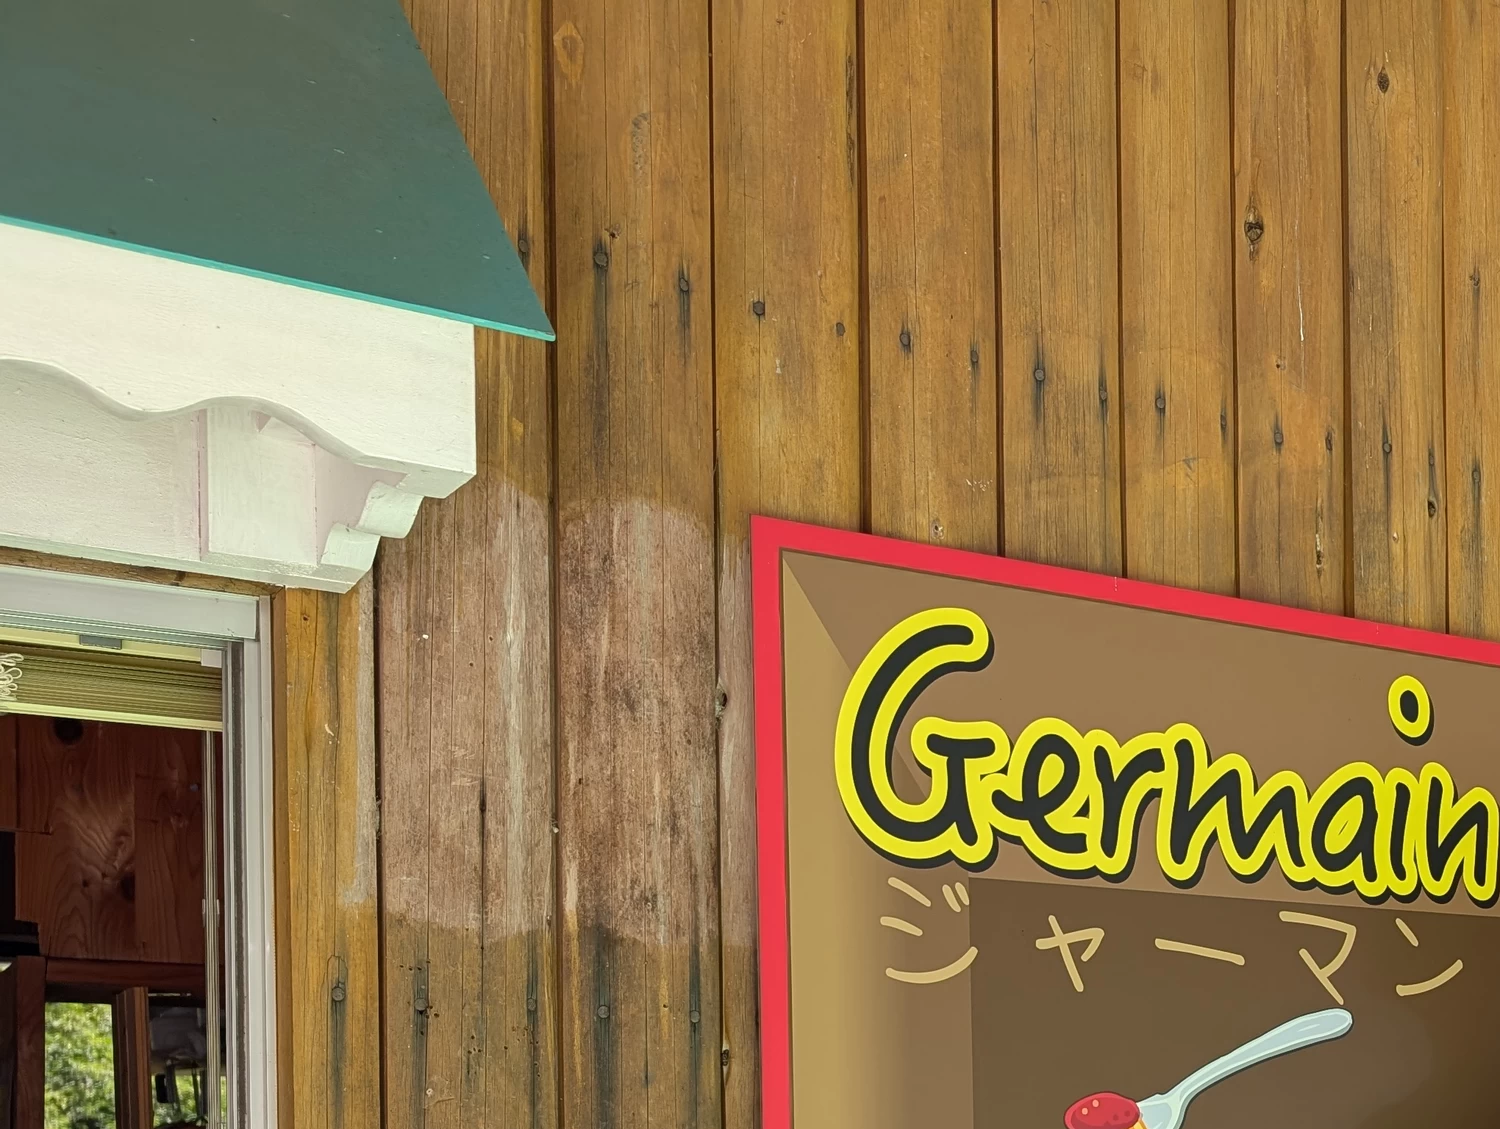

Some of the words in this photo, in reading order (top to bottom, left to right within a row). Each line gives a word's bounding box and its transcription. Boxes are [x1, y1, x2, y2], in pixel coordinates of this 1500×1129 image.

[880, 876, 1464, 1004] ジャーマン
